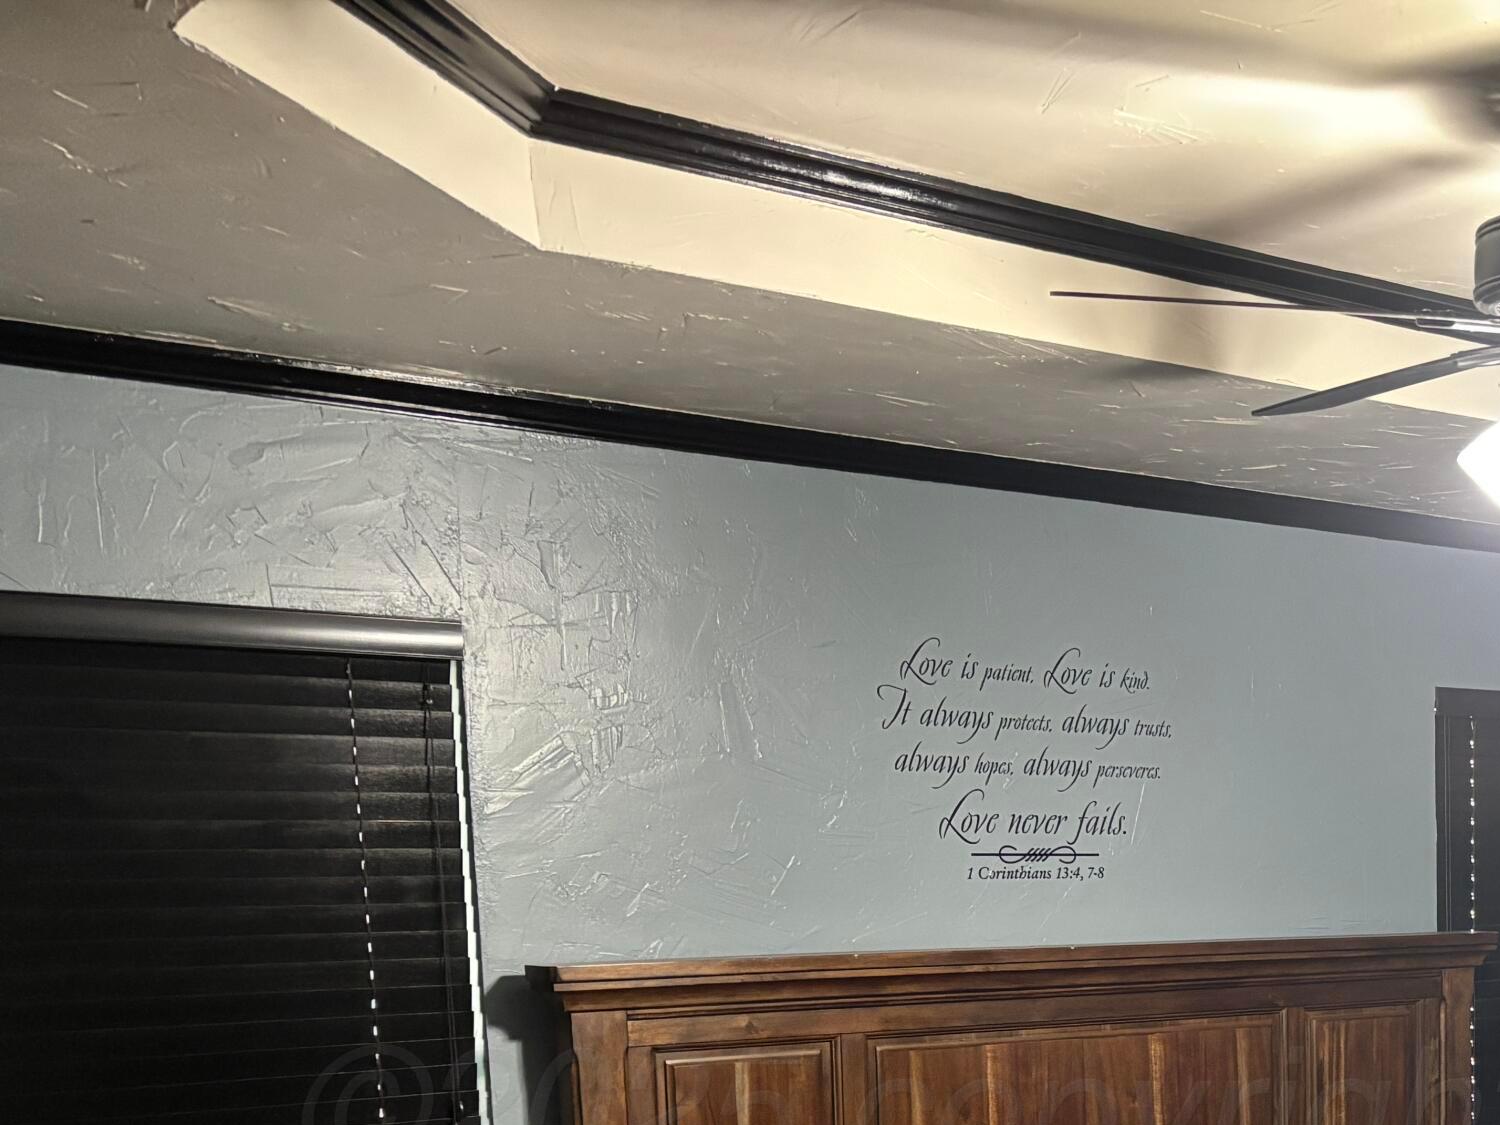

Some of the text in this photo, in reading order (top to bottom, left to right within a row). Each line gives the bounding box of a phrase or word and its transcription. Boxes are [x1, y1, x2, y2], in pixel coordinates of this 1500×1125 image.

[899, 636, 953, 686] Love
[960, 652, 980, 680] is
[1043, 647, 1094, 695] Love
[1099, 662, 1116, 688] is
[1119, 666, 1150, 694] kind.
[876, 684, 912, 730] It
[919, 696, 994, 745] always
[1062, 704, 1130, 750] always
[894, 741, 970, 789] always
[1023, 747, 1093, 792] always
[938, 788, 1127, 845] Love never fails.
[966, 865, 1105, 882] 1 Corinthians 13:4, 7-8
